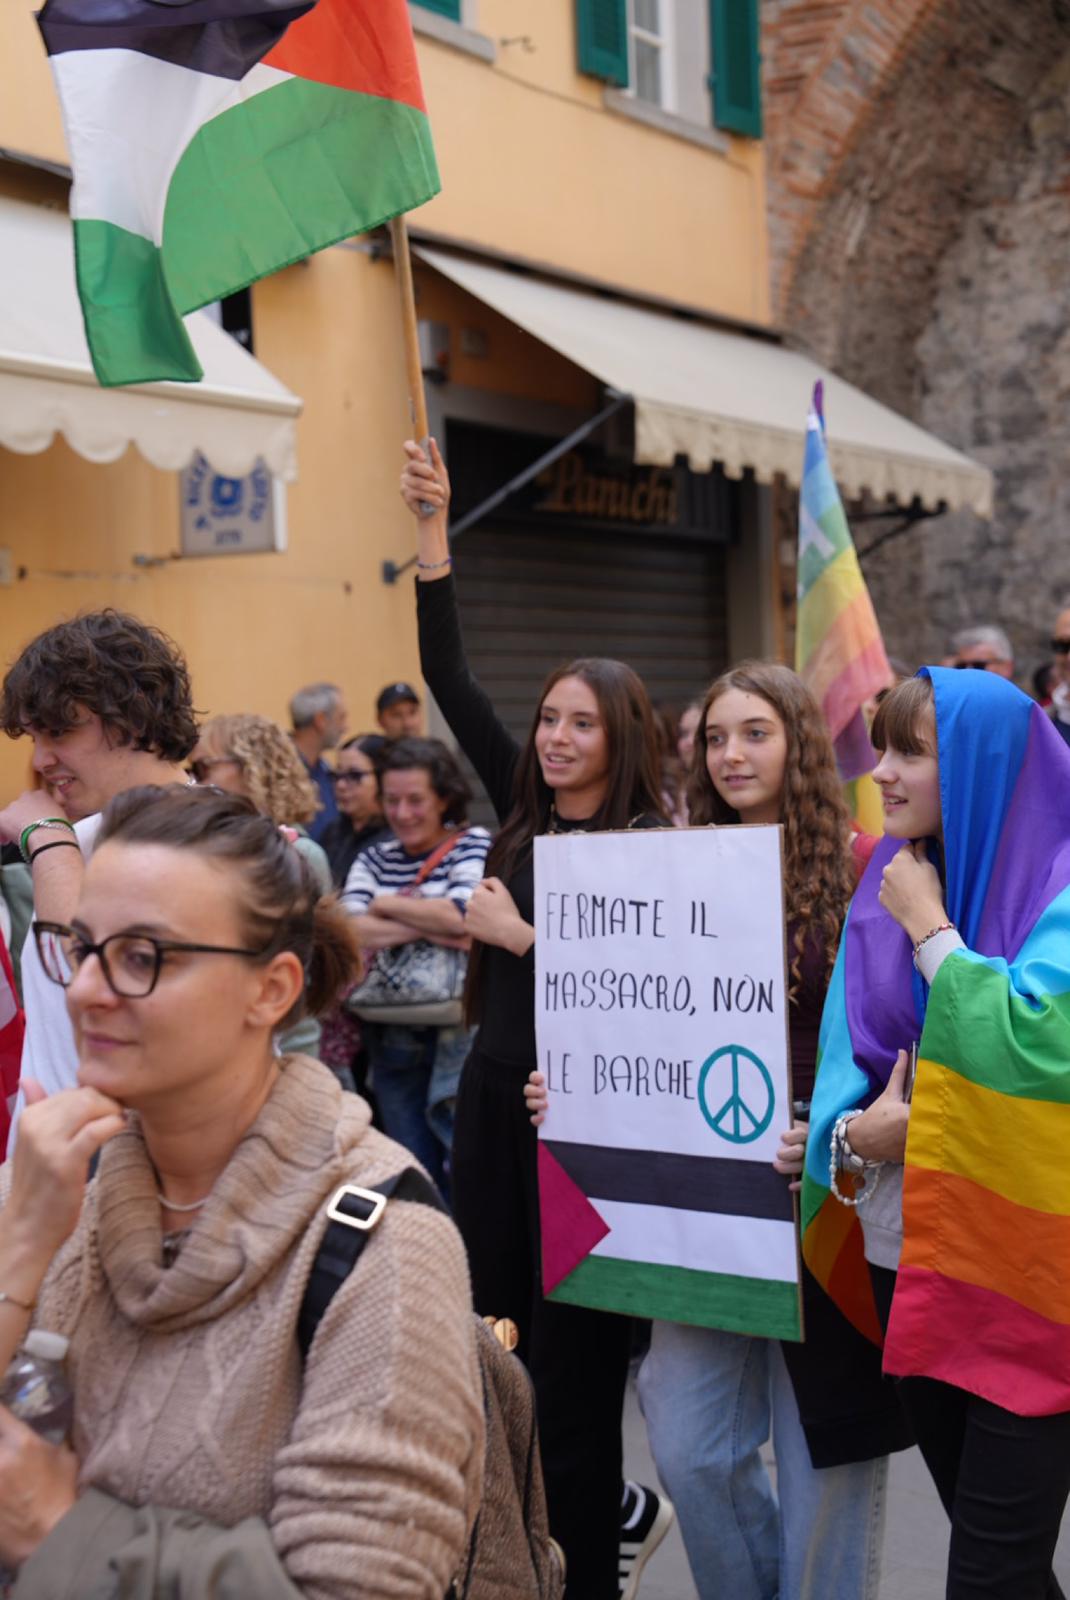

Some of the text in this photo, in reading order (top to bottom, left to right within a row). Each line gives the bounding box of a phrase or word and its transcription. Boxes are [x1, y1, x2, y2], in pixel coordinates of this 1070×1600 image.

[546, 892, 718, 941] FERMATE IL
[545, 968, 775, 1016] MASSACRO, NON
[547, 1050, 695, 1100] LE BARCHE
